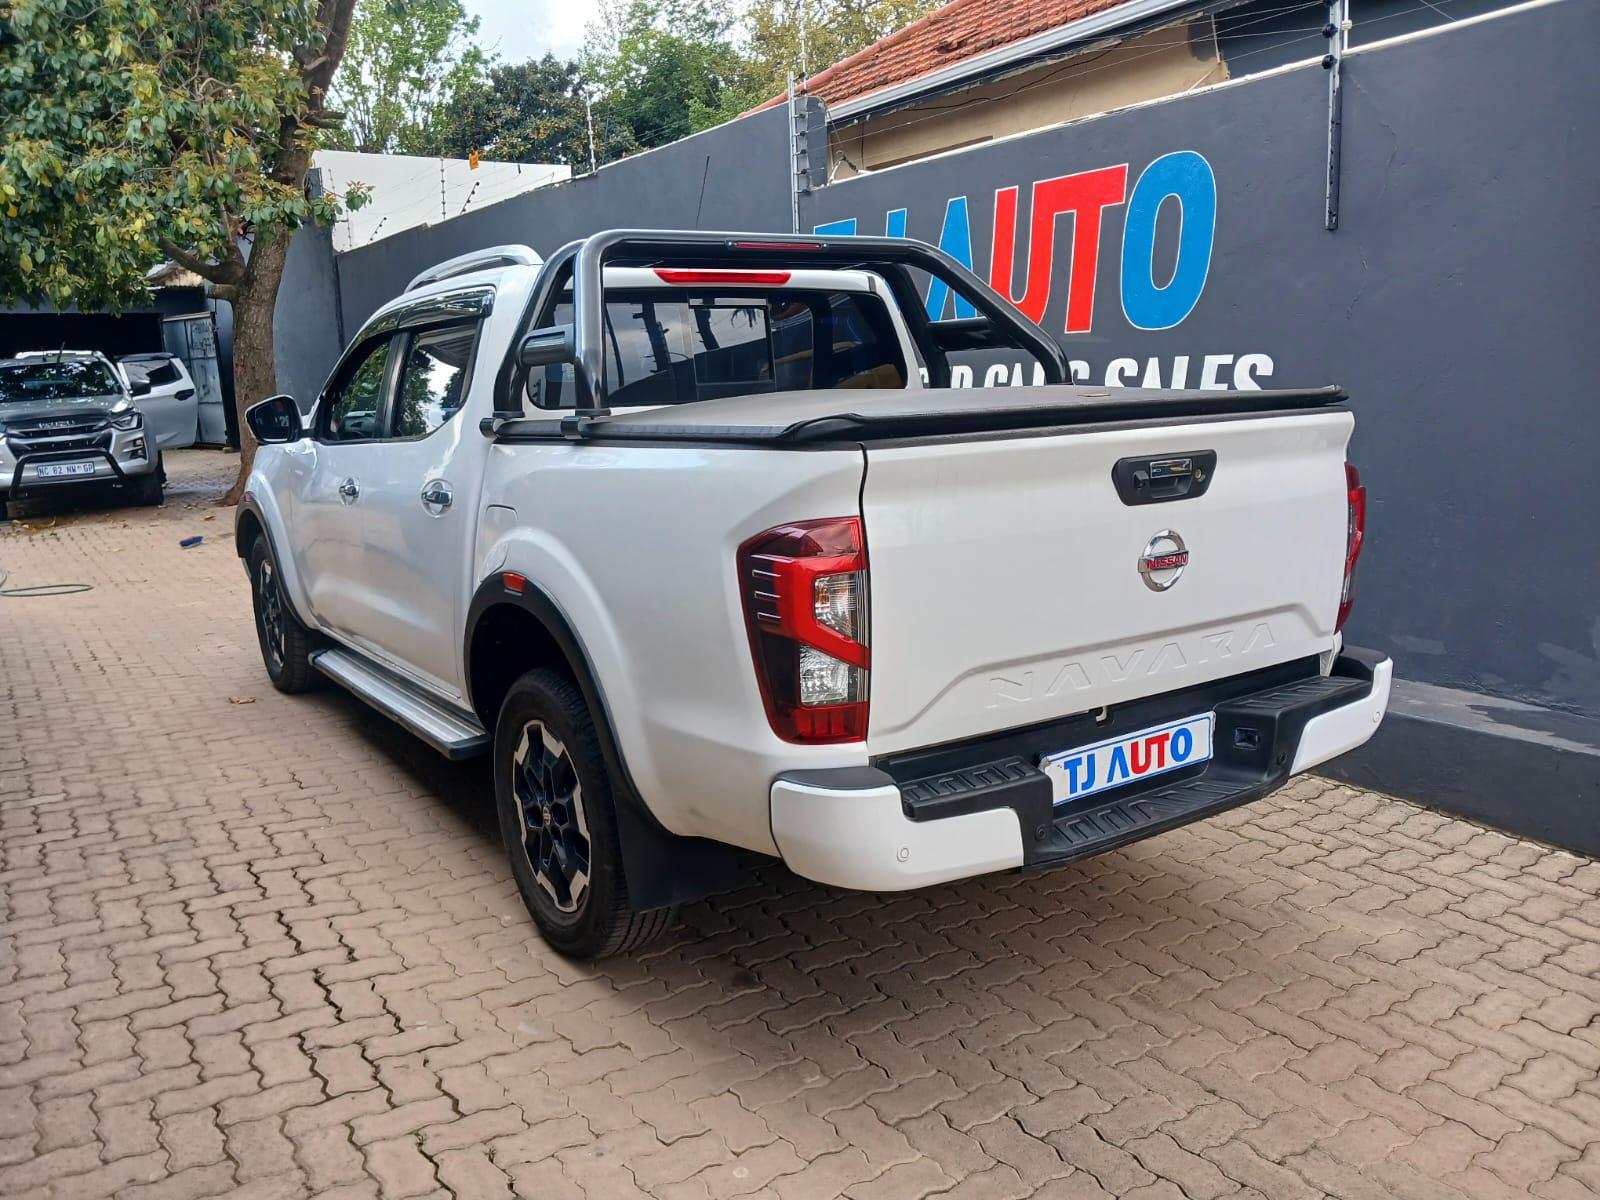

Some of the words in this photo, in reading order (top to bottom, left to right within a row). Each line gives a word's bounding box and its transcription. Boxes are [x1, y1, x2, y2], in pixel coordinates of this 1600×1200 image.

[924, 150, 1216, 333] AUTO
[1147, 553, 1187, 570] NISSAN
[987, 622, 1276, 708] NAVARA
[1064, 753, 1096, 795] TJ
[1107, 727, 1193, 783] AUTO
